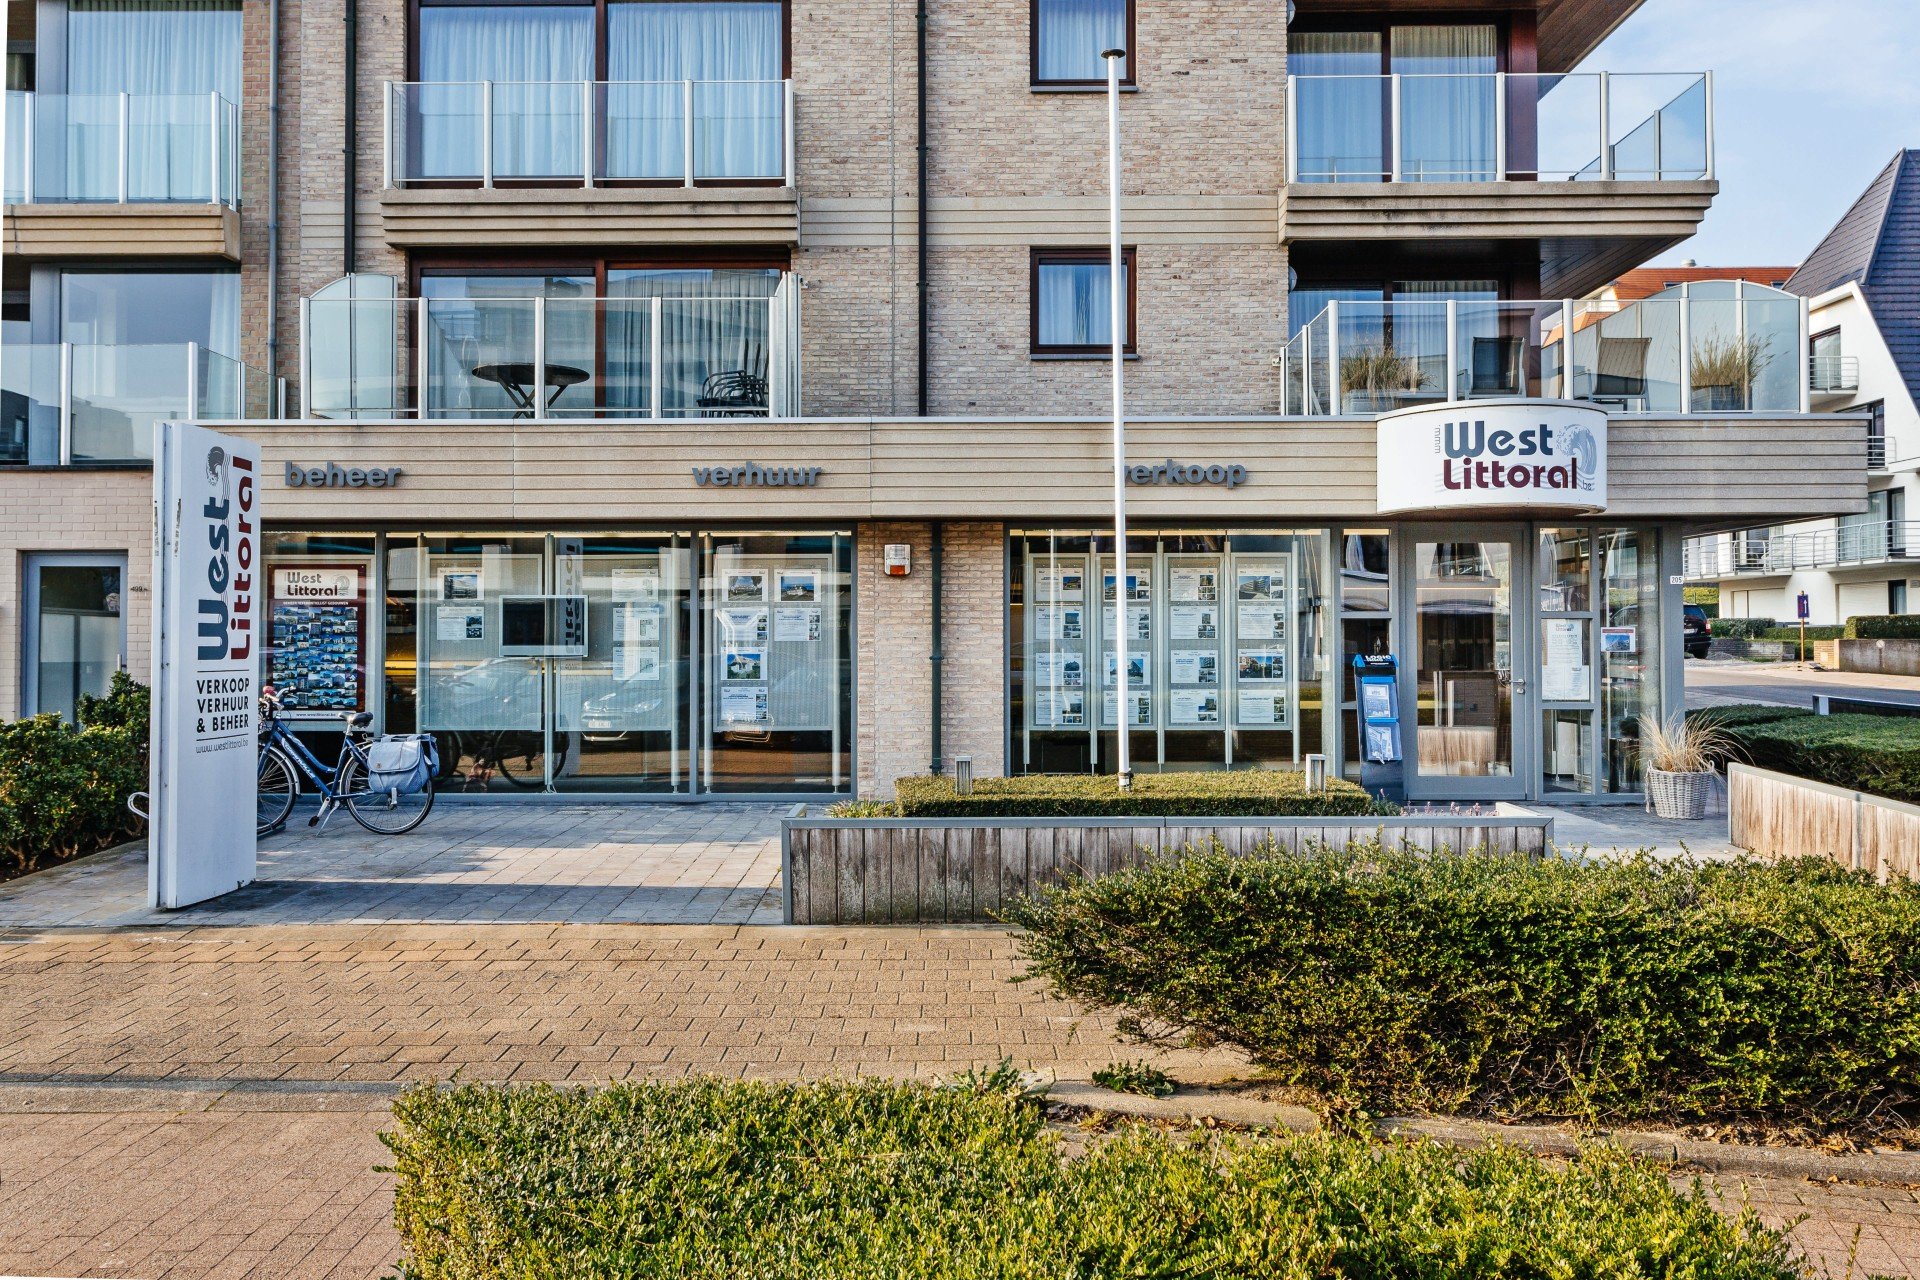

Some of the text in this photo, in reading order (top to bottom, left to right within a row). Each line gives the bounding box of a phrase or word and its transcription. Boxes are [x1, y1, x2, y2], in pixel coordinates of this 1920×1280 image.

[1444, 420, 1553, 459] West
[285, 461, 402, 487] beheer
[692, 461, 822, 486] verhuur
[1443, 457, 1578, 490] Littoral
[231, 456, 252, 660] Littoral
[198, 496, 230, 660] West
[287, 571, 322, 584] West
[1671, 576, 1682, 584] 205
[287, 584, 338, 597] Littoral
[196, 678, 250, 695] VERKOOP
[197, 695, 249, 714] VERHUUR
[196, 714, 249, 734] & BEHEER
